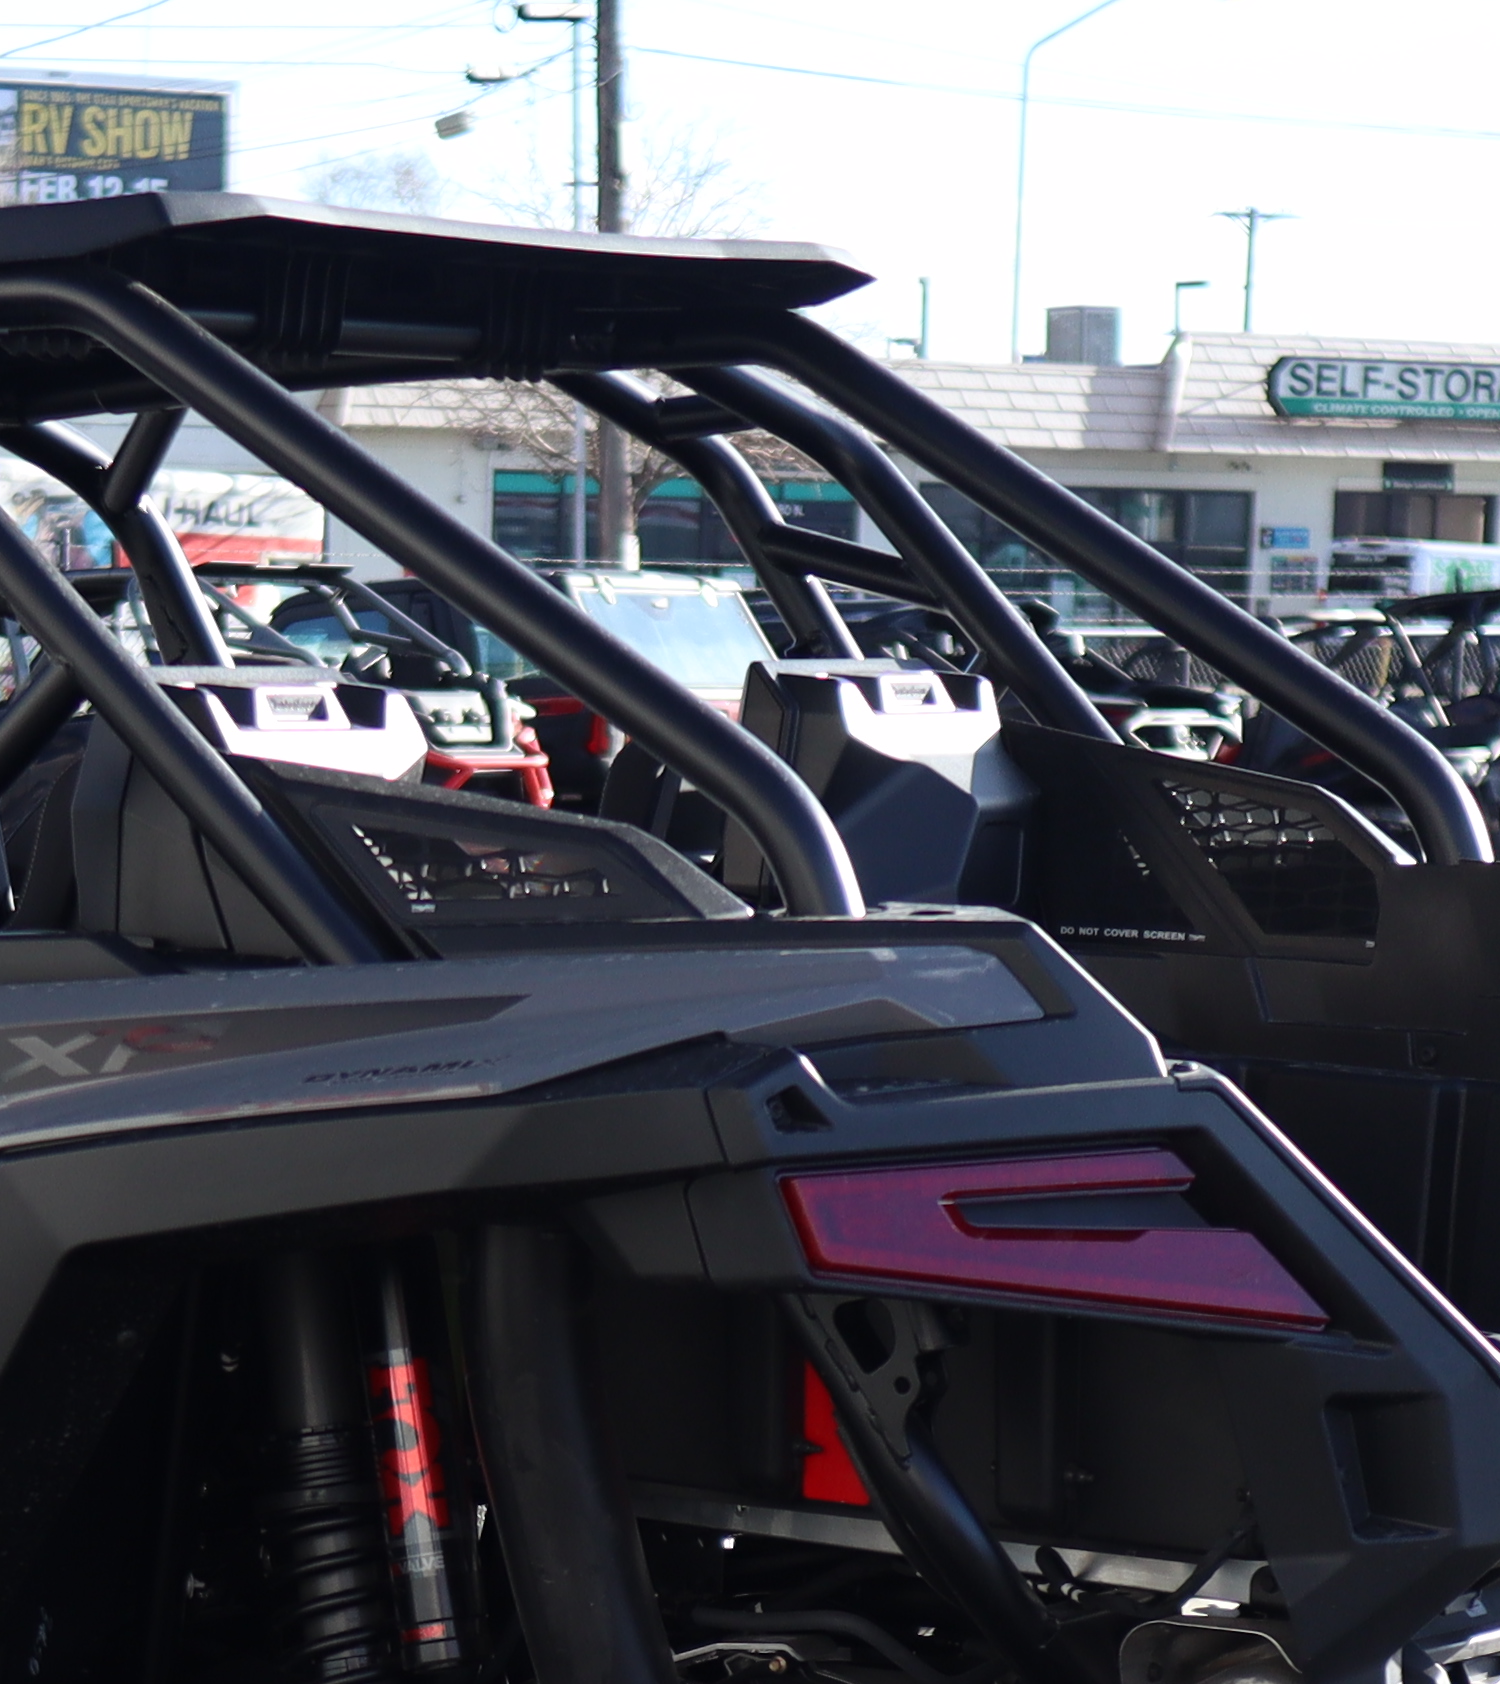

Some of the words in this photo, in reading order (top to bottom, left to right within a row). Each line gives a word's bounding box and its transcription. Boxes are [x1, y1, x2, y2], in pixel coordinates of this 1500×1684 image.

[21, 102, 75, 155] RV
[81, 105, 194, 161] SHOW
[1060, 926, 1075, 935] DO
[1078, 926, 1100, 937] NOT
[1103, 927, 1139, 939] COVER
[1142, 929, 1187, 942] SCREEN
[367, 1355, 452, 1538] FOX
